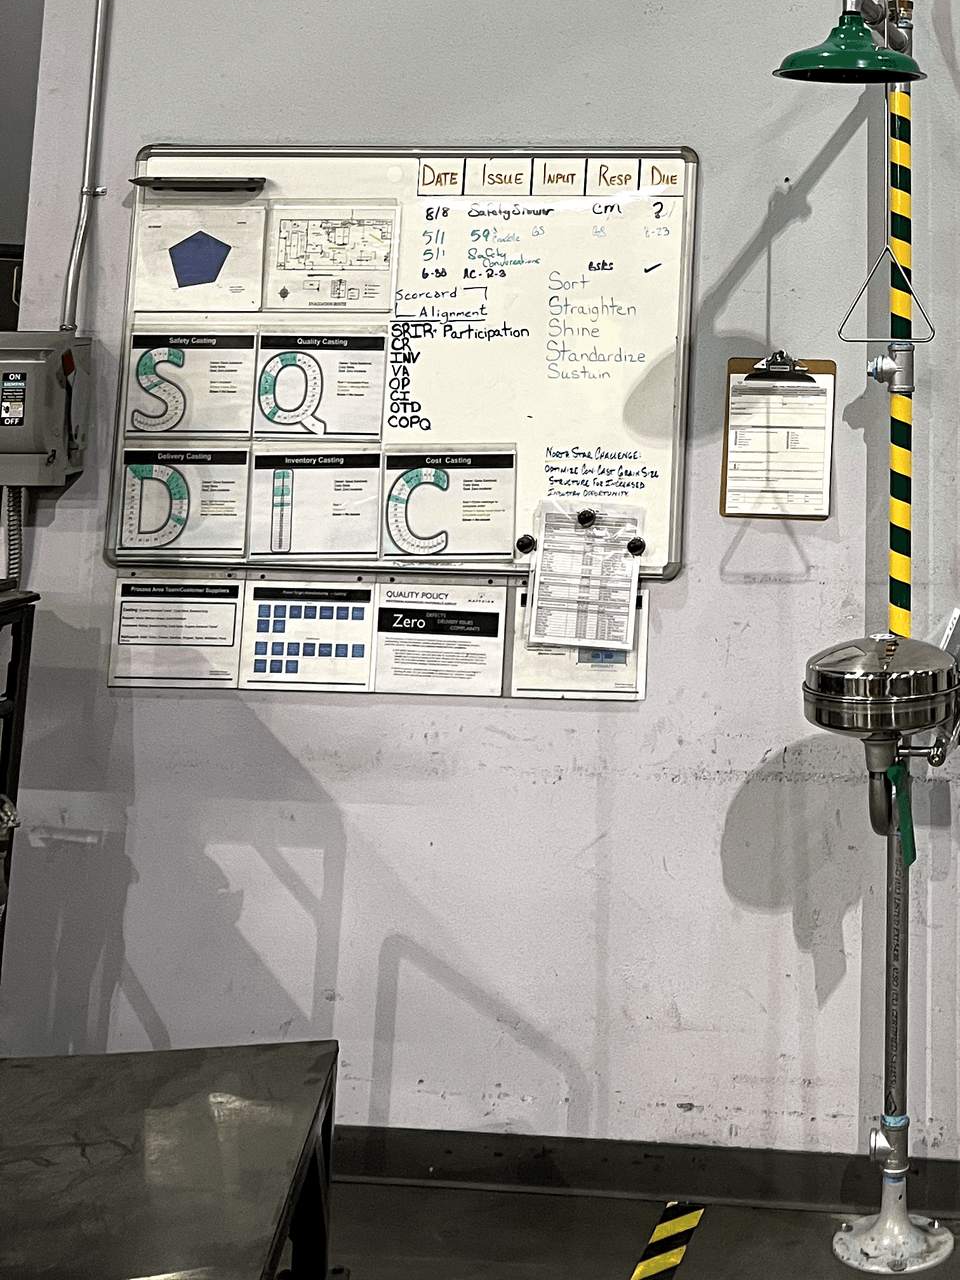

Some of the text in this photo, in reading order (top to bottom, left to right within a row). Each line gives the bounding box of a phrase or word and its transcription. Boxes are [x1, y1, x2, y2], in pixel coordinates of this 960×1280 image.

[422, 164, 458, 186] DATE
[482, 163, 524, 186] ISSUE
[543, 163, 577, 186] INPUT
[598, 164, 632, 187] RESP
[651, 165, 678, 186] DUE
[548, 271, 590, 291] Sort
[418, 304, 488, 324] Alignment
[549, 295, 637, 322] Straighten
[443, 323, 530, 342] Participation
[548, 317, 600, 338] Shine
[168, 337, 217, 346] Safety Casting
[297, 337, 348, 347] Quality Casting
[391, 337, 412, 352] CR
[390, 351, 421, 365] INV
[546, 339, 646, 363] Standardize
[391, 364, 410, 377] VA
[547, 363, 611, 380] Sustain
[388, 377, 410, 391] OP
[390, 390, 410, 402] CI
[390, 401, 422, 414] OTD
[4, 417, 20, 425] OFF
[387, 415, 432, 431] COPQ
[157, 452, 212, 461] Delivery Casting
[285, 456, 344, 465] Inventory Casting
[425, 456, 472, 465] Cost Casting
[385, 590, 449, 600] QUALITY POLICY
[392, 613, 426, 628] Zero
